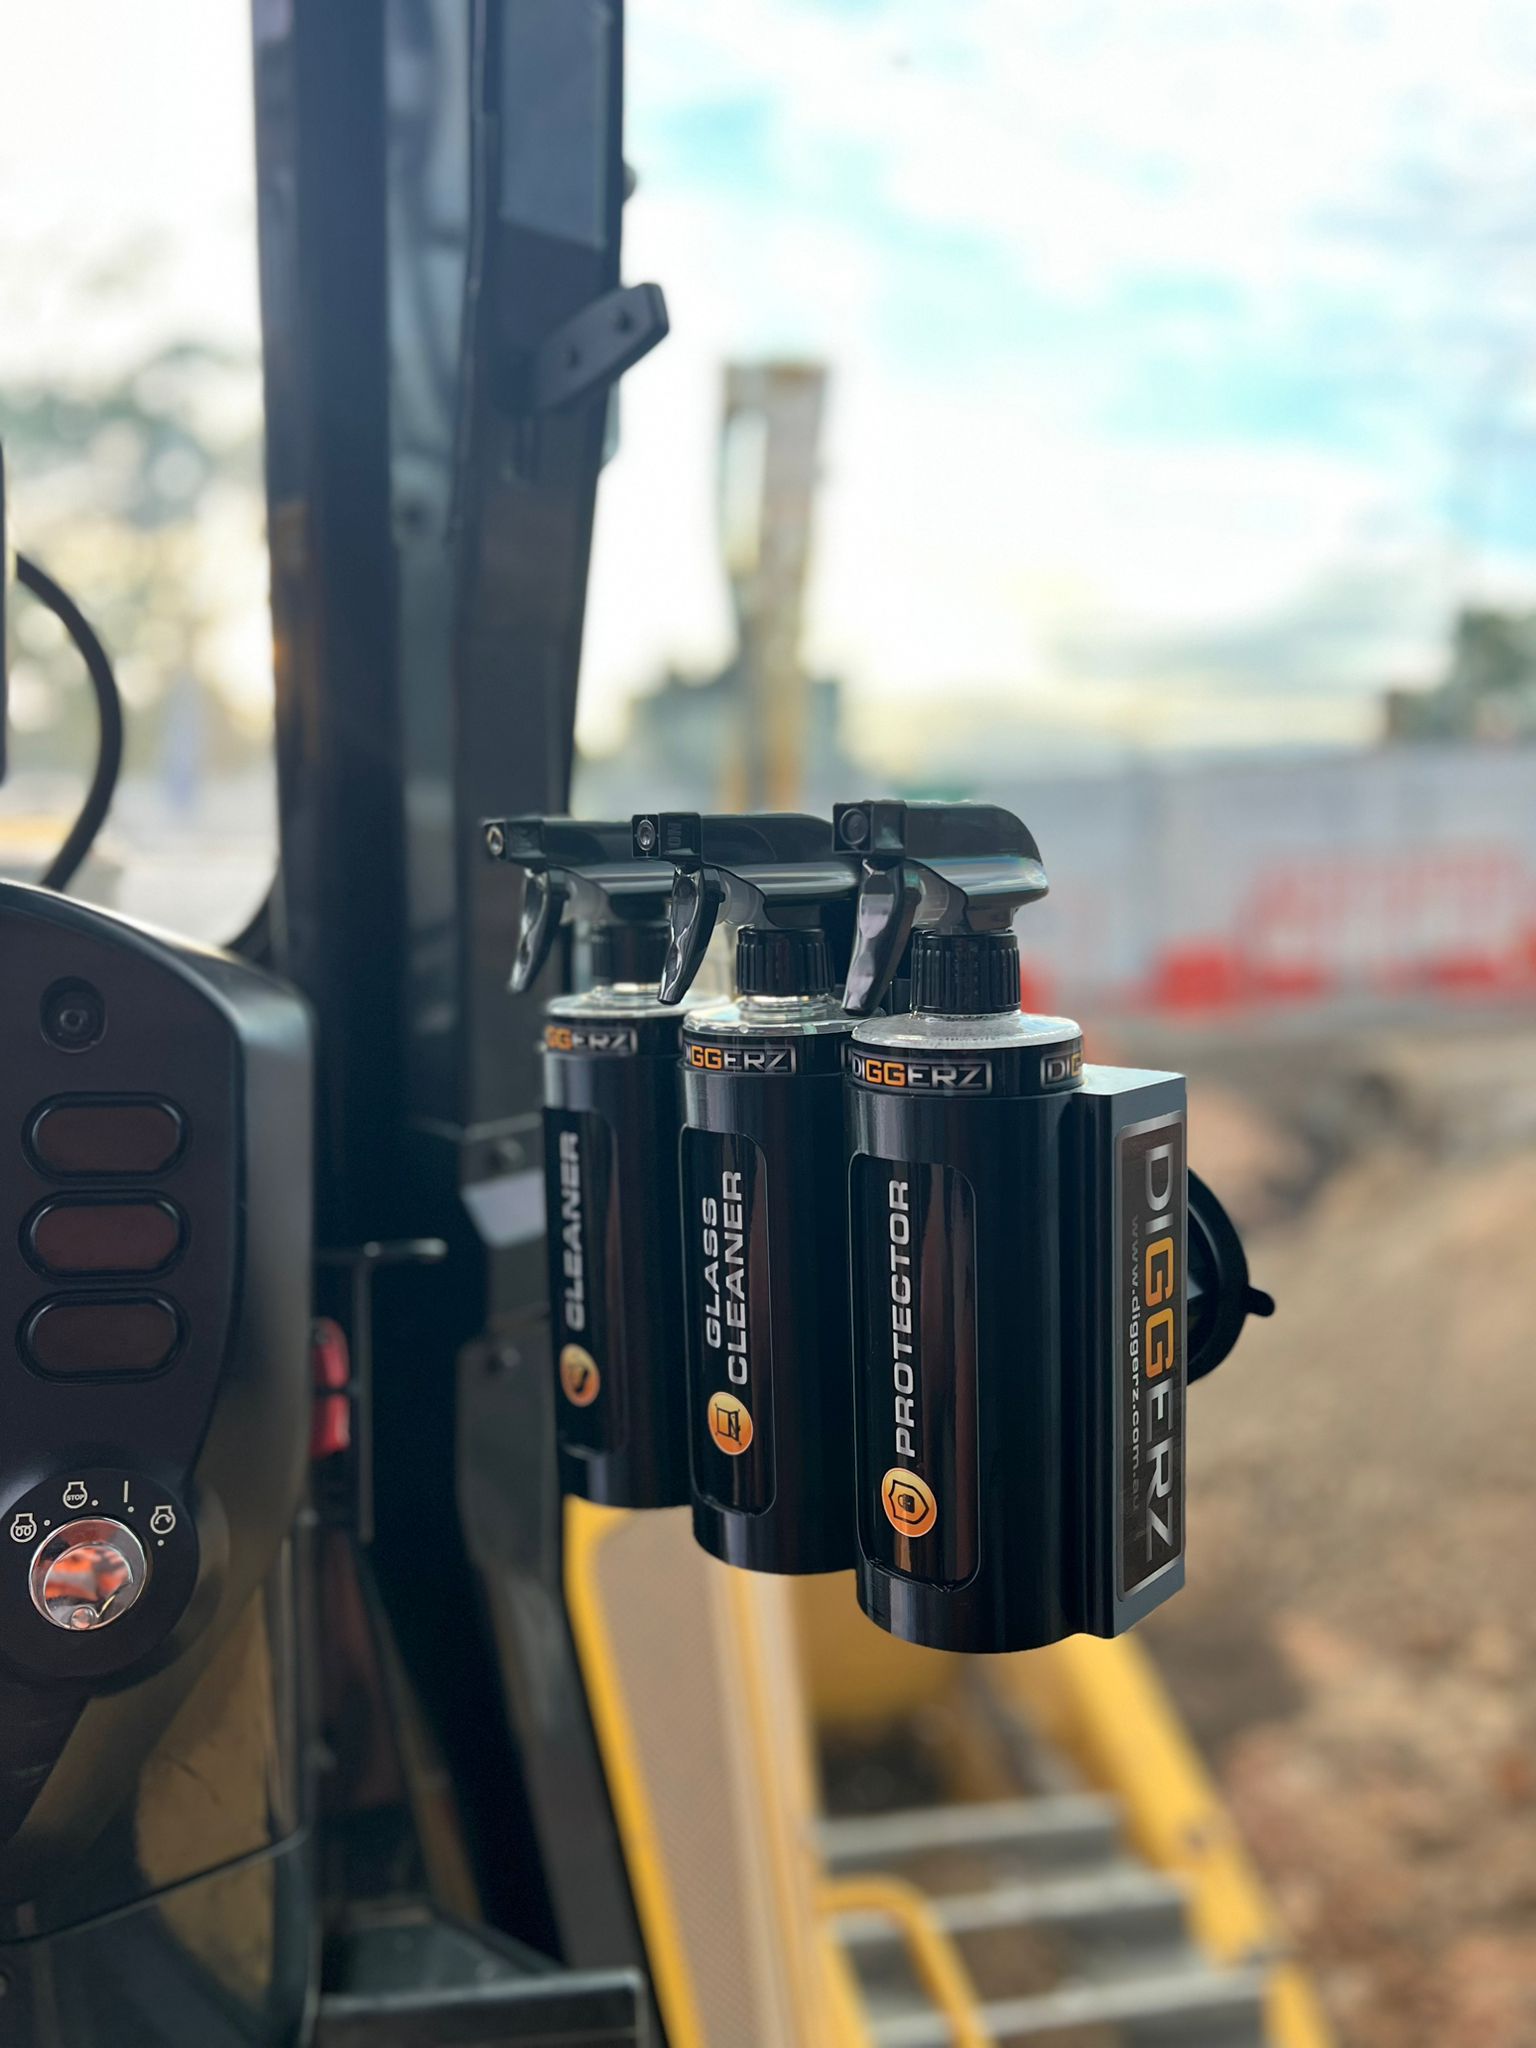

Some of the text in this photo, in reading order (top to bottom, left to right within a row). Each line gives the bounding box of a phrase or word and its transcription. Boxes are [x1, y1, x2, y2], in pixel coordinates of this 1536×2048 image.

[852, 1058, 988, 1089] DIGGERZ
[559, 1130, 585, 1333] CLEANER
[702, 1196, 722, 1349] GLASS
[721, 1170, 749, 1386] CLEANER
[888, 1179, 916, 1458] PROTECTOR
[1127, 1215, 1141, 1511] www.diggerz.com.au
[1144, 1142, 1176, 1562] DIGGERZ
[66, 1494, 85, 1502] STOP
